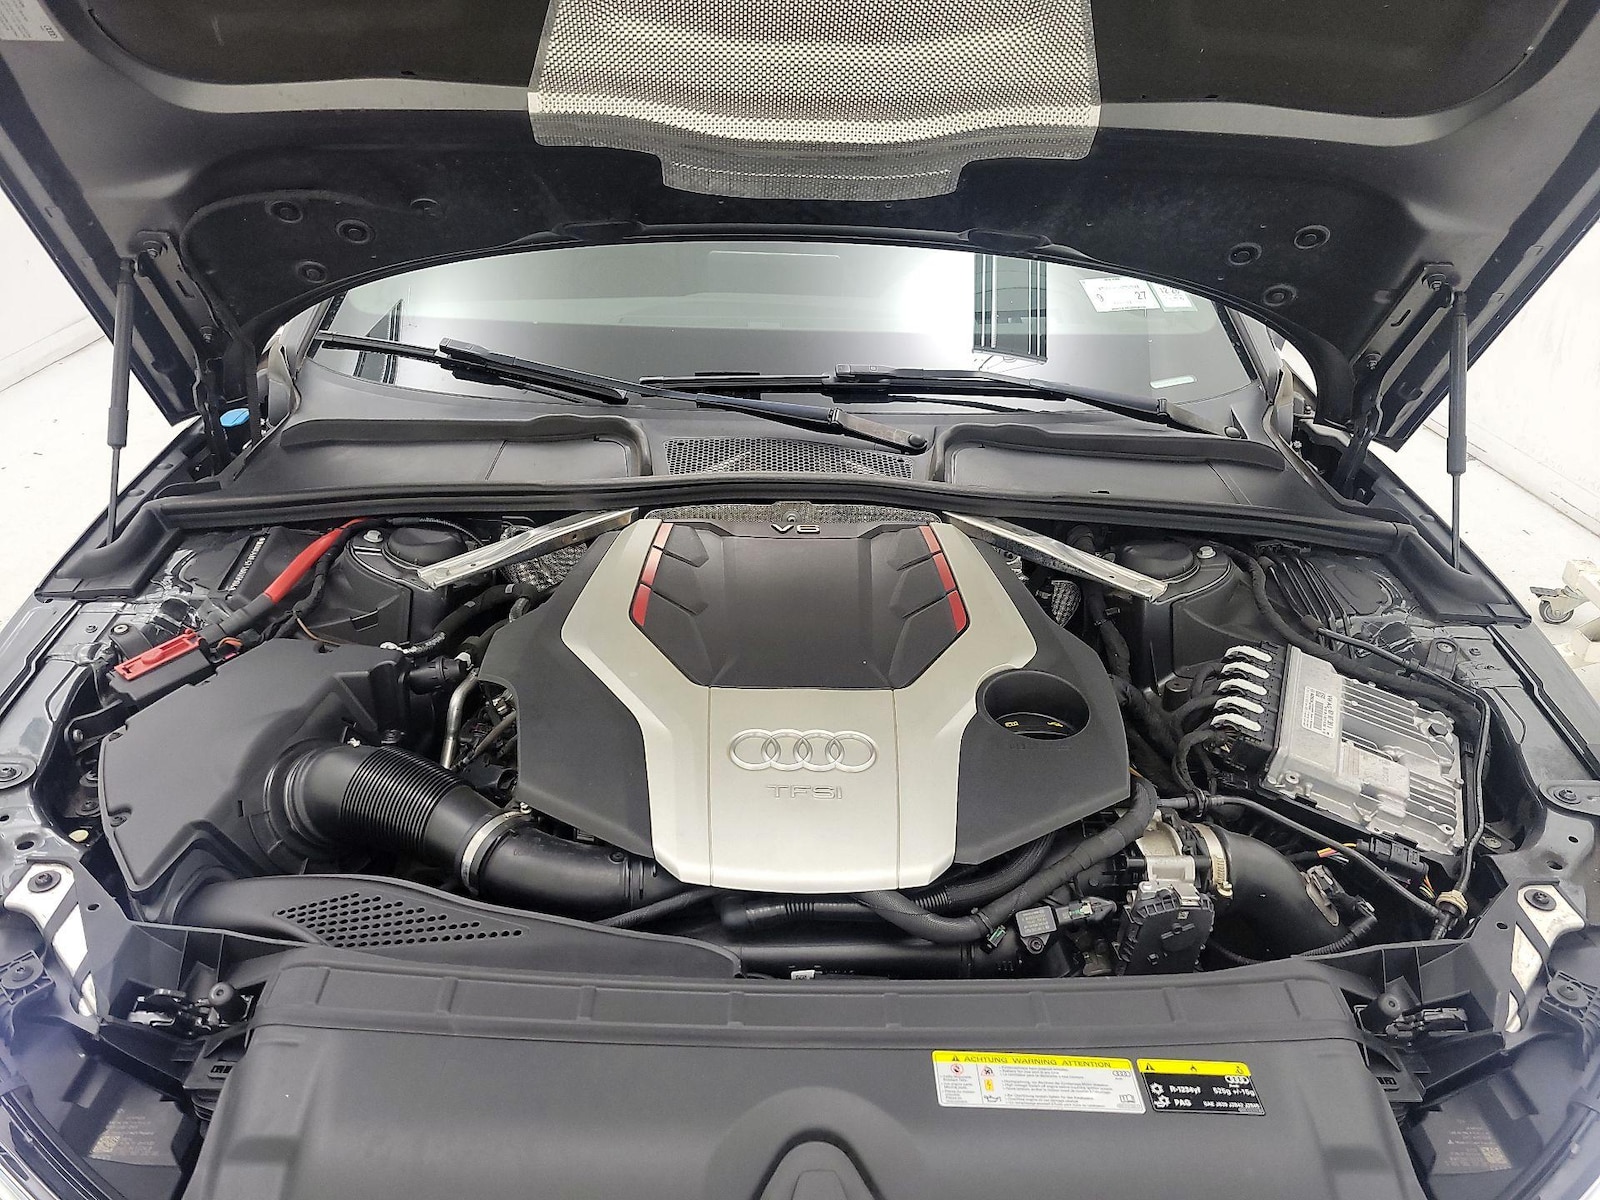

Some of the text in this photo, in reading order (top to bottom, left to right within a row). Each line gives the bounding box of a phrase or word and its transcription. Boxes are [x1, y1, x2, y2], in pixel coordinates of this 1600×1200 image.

[1134, 291, 1147, 300] 27
[771, 523, 821, 534] V6
[767, 784, 843, 800] TFSI
[964, 1056, 1112, 1068] ACHTUNG WARNING ATTENTION
[1174, 1099, 1192, 1107] PAG
